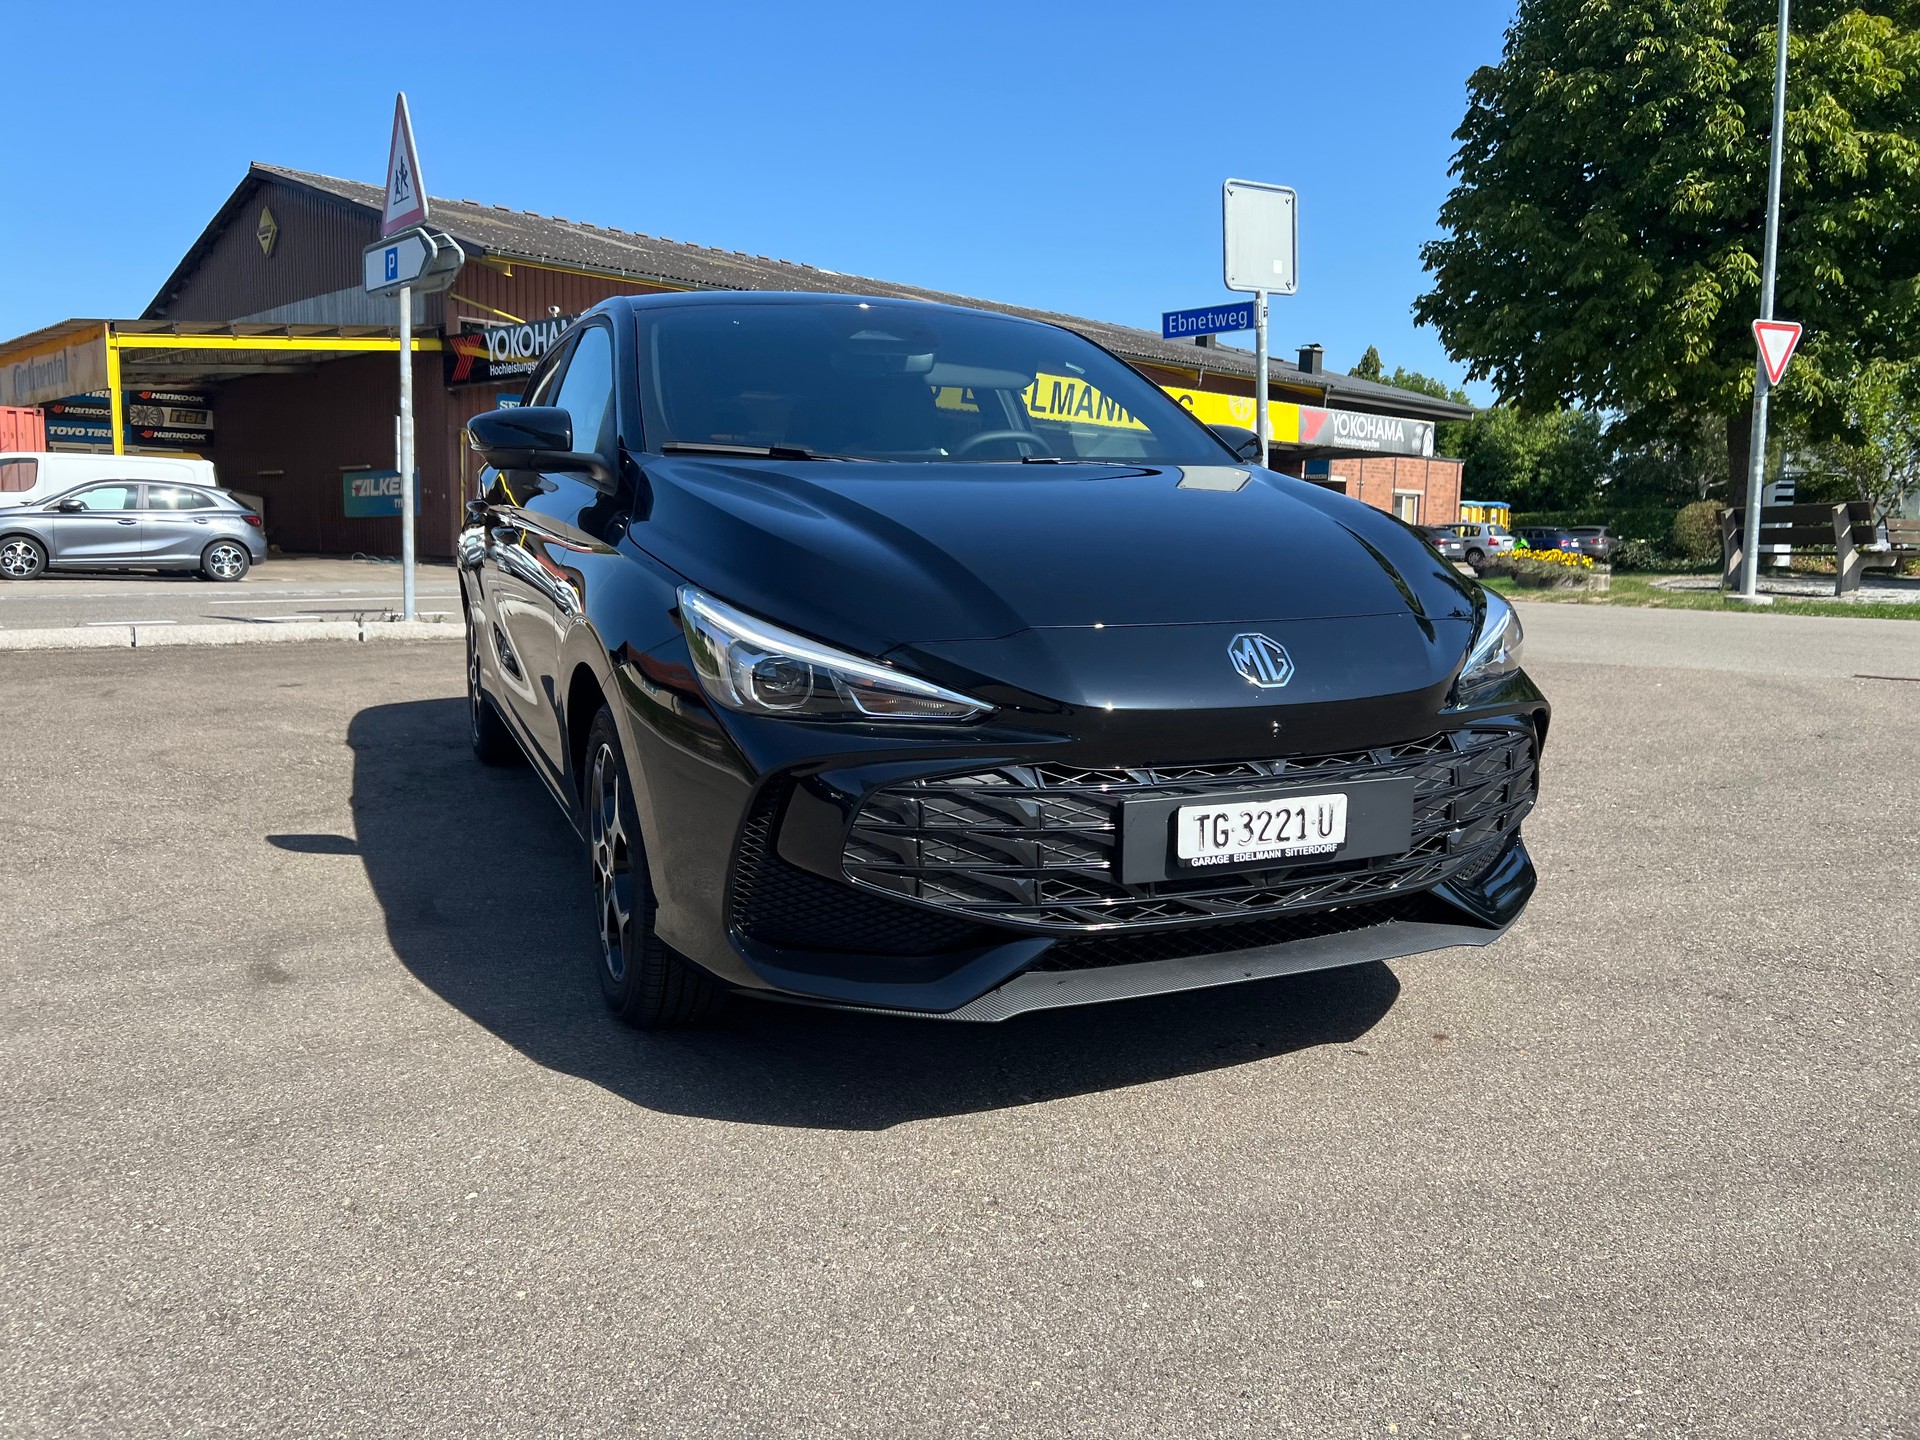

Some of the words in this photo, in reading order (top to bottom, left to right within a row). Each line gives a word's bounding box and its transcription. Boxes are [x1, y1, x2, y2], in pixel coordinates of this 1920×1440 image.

[1169, 309, 1248, 333] Ebnetweg
[1331, 412, 1405, 443] YOKOHAMA
[351, 476, 403, 497] FALKE
[1232, 637, 1289, 682] MG
[1191, 853, 1230, 867] GARAGE
[1233, 849, 1282, 863] EDELMANN
[1285, 843, 1338, 857] SITTERDORF
